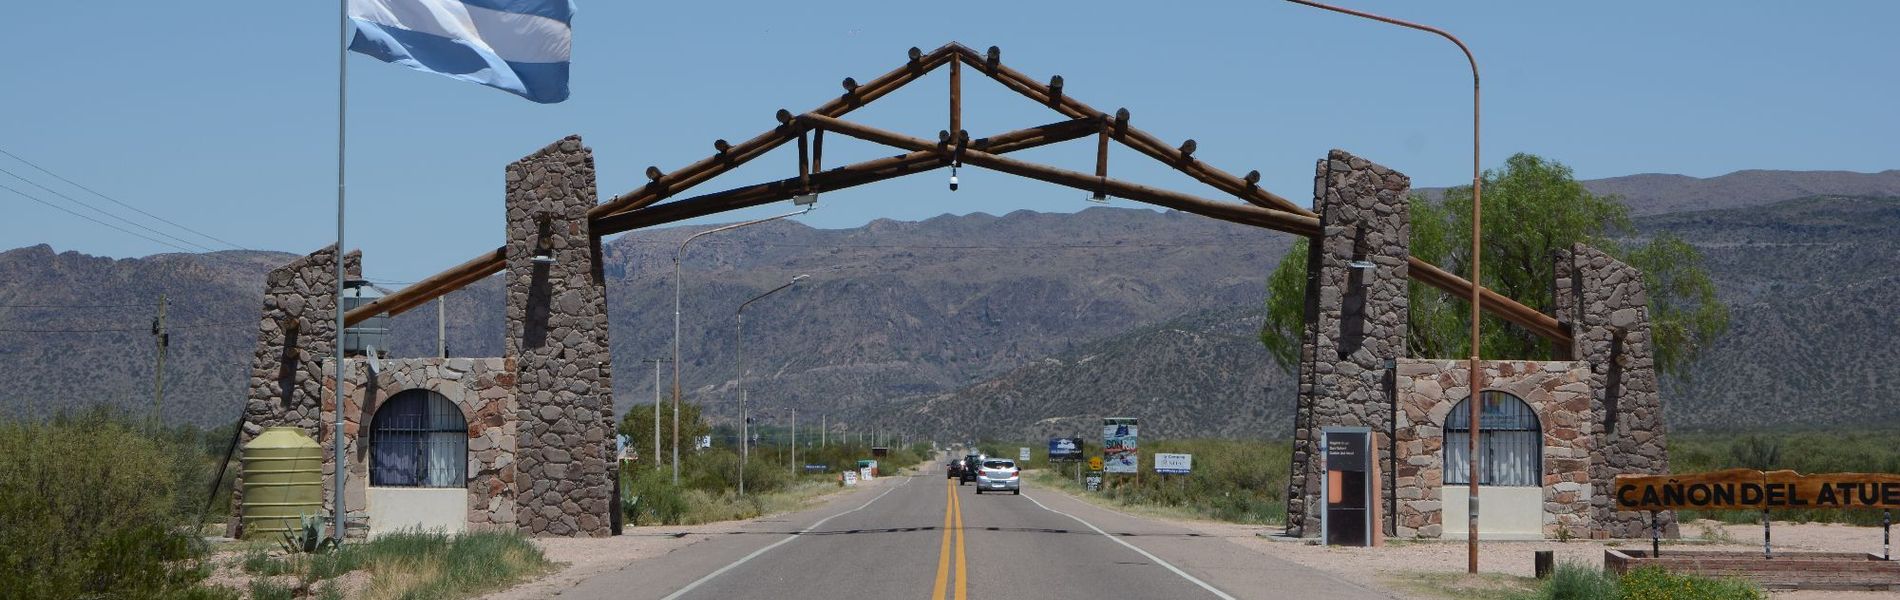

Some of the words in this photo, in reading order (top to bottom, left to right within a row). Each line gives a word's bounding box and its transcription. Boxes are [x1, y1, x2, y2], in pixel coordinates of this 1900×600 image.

[1617, 479, 1735, 507] CAÑON
[1741, 483, 1808, 506] DEL
[1816, 483, 1900, 506] ATUE
